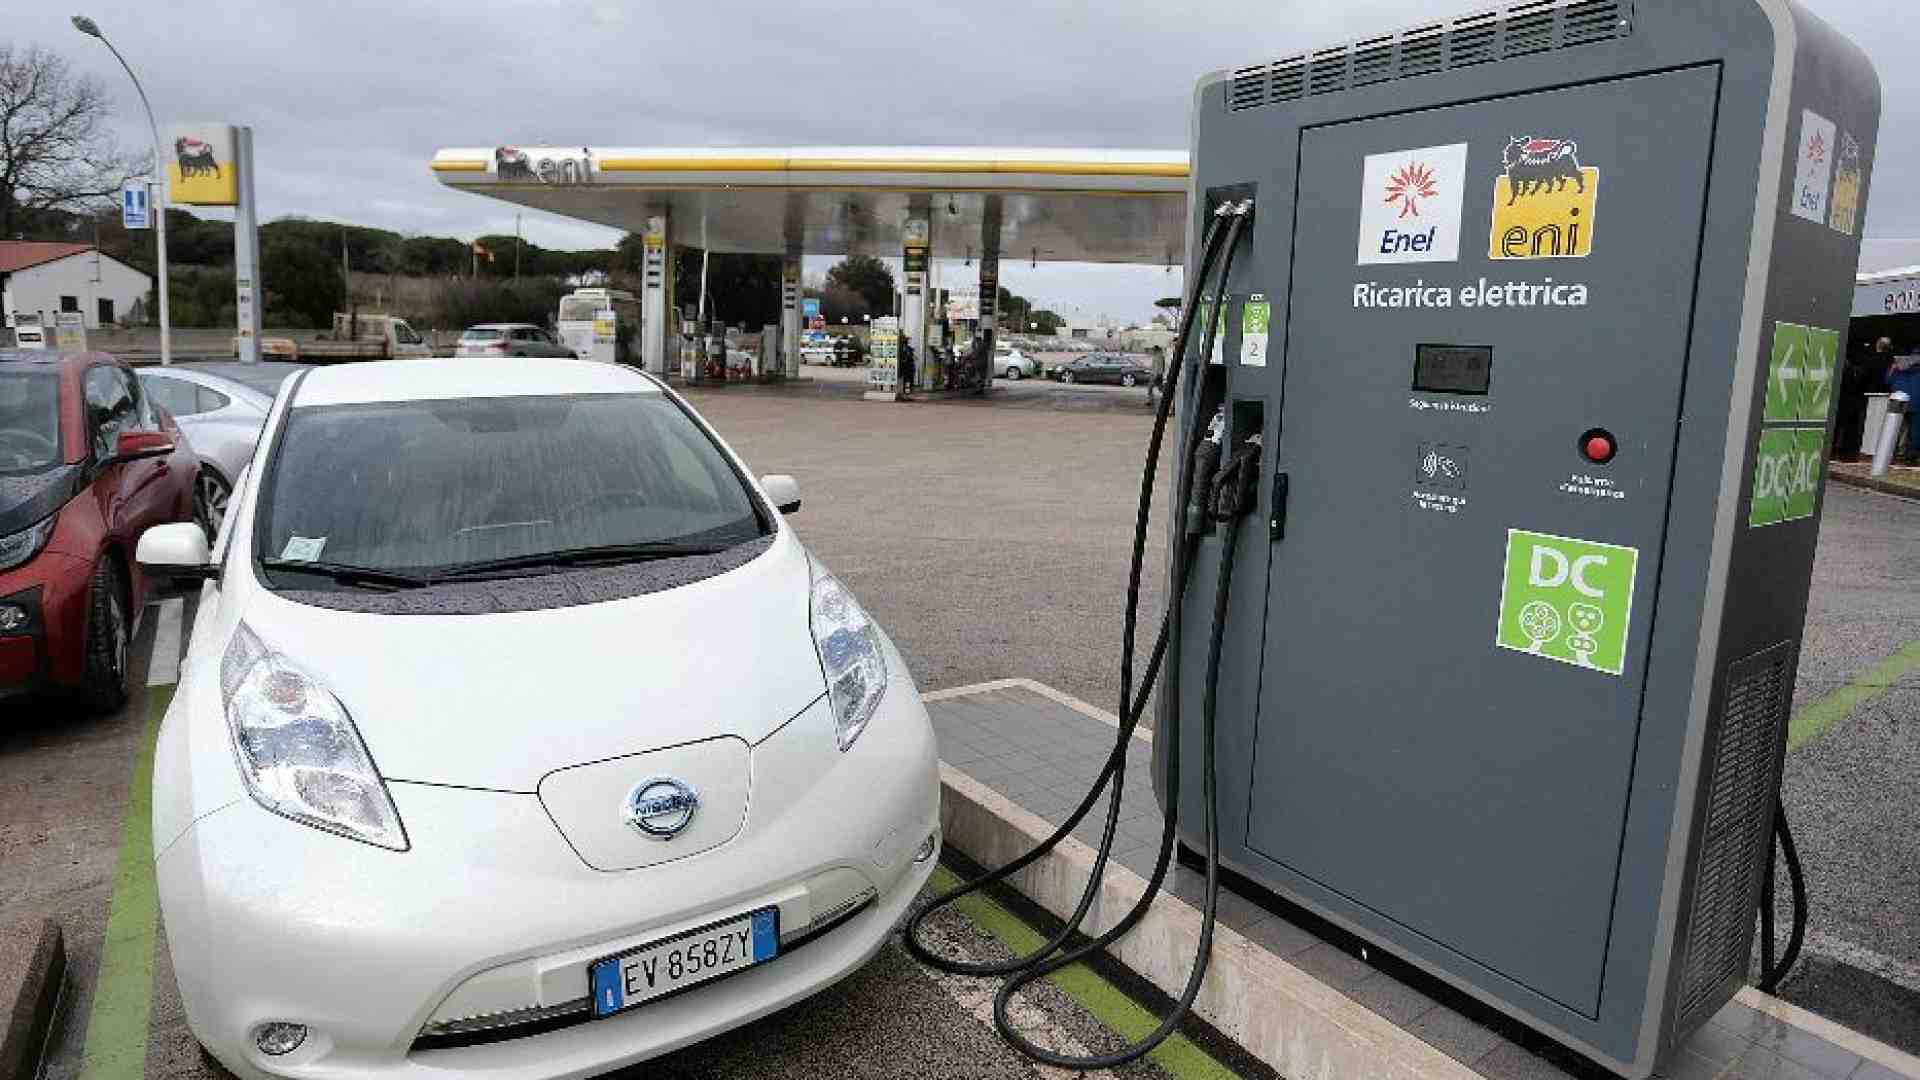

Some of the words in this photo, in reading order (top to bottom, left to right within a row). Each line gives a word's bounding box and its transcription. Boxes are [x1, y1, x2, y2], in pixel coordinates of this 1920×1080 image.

[537, 147, 592, 184] eni
[1380, 226, 1437, 254] Enel
[1502, 207, 1579, 257] eni
[1353, 279, 1452, 308] Ricarica
[1460, 277, 1588, 307] elettrica
[1884, 283, 1914, 311] eni
[1250, 342, 1259, 356] 2
[1758, 454, 1791, 498] DC
[1791, 451, 1822, 492] AC
[1529, 544, 1608, 598] DC
[625, 956, 657, 996] EV
[668, 927, 750, 981] 858ZY
